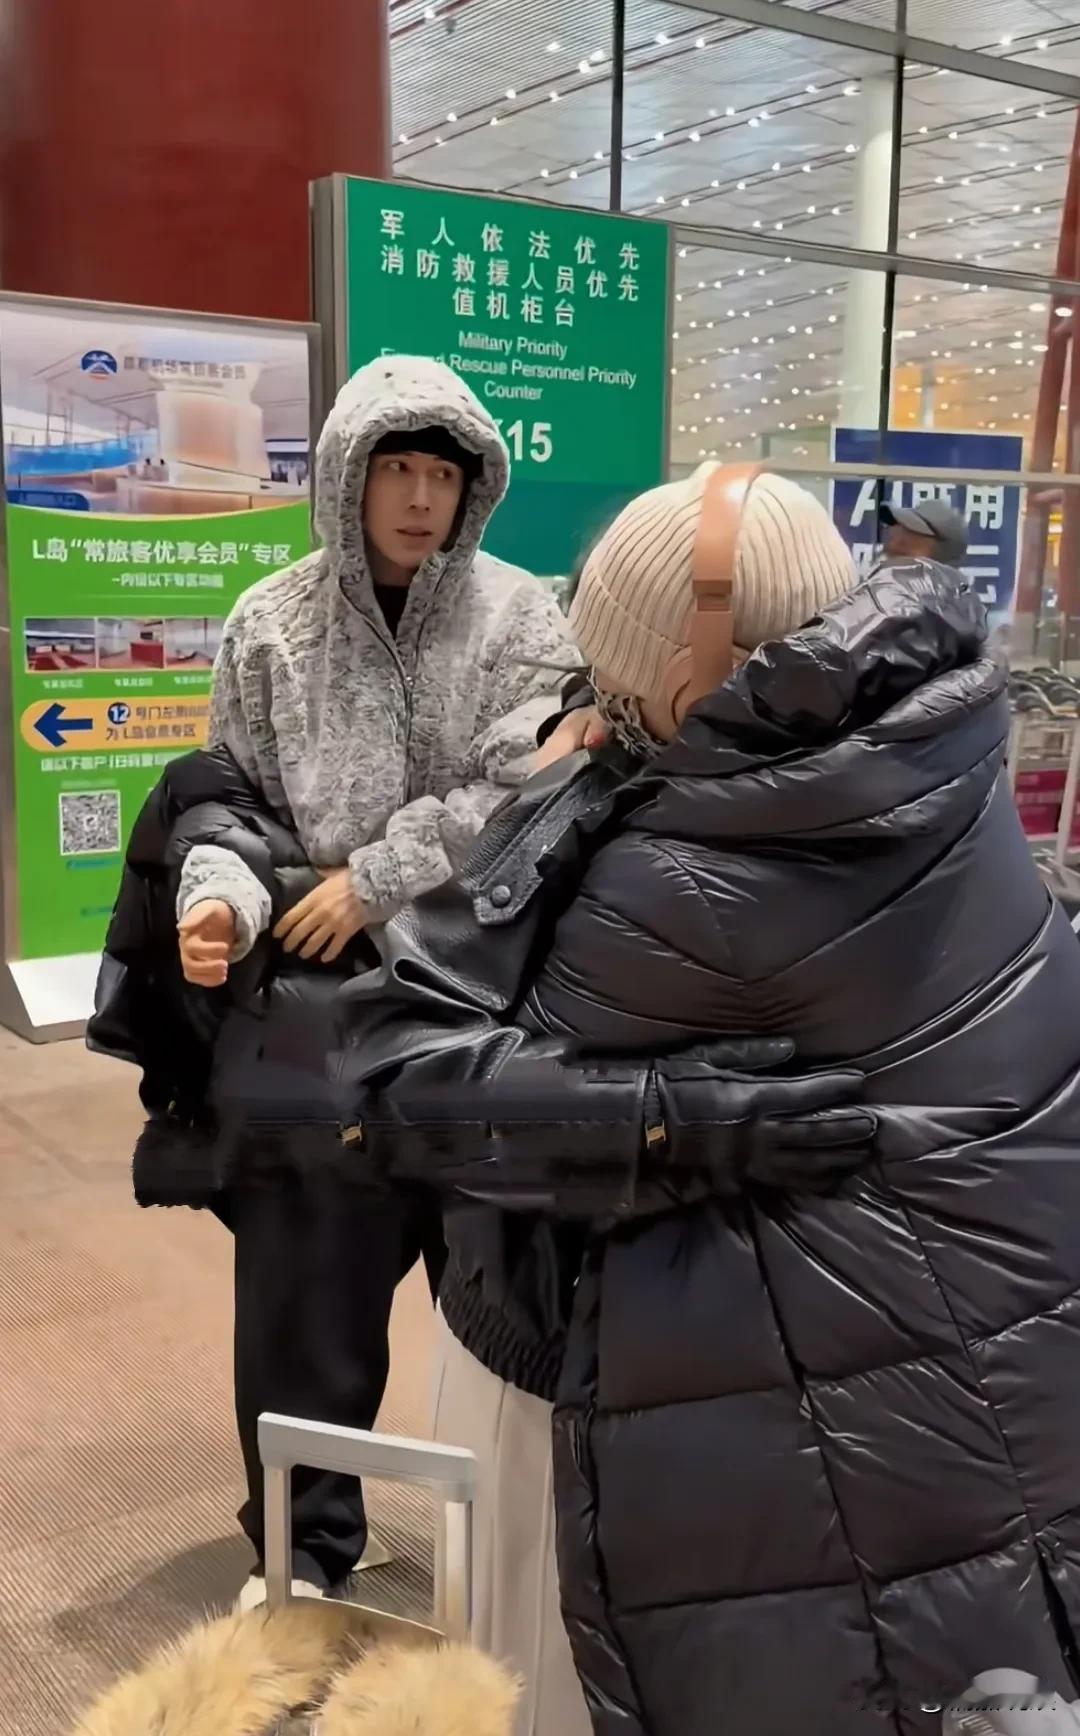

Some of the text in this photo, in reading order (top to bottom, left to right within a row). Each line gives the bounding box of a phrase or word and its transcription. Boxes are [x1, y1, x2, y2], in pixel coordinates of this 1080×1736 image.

[381, 208, 639, 271] 军人依法优先
[381, 244, 639, 302] 消防救援人员优先
[452, 286, 575, 328] 值机柜台
[458, 330, 513, 356] Military
[517, 336, 568, 361] Priority
[450, 354, 507, 375] Rescue
[511, 359, 584, 382] Personnel
[588, 369, 637, 389] Priority
[484, 380, 543, 401] Counter
[497, 418, 553, 463] 15
